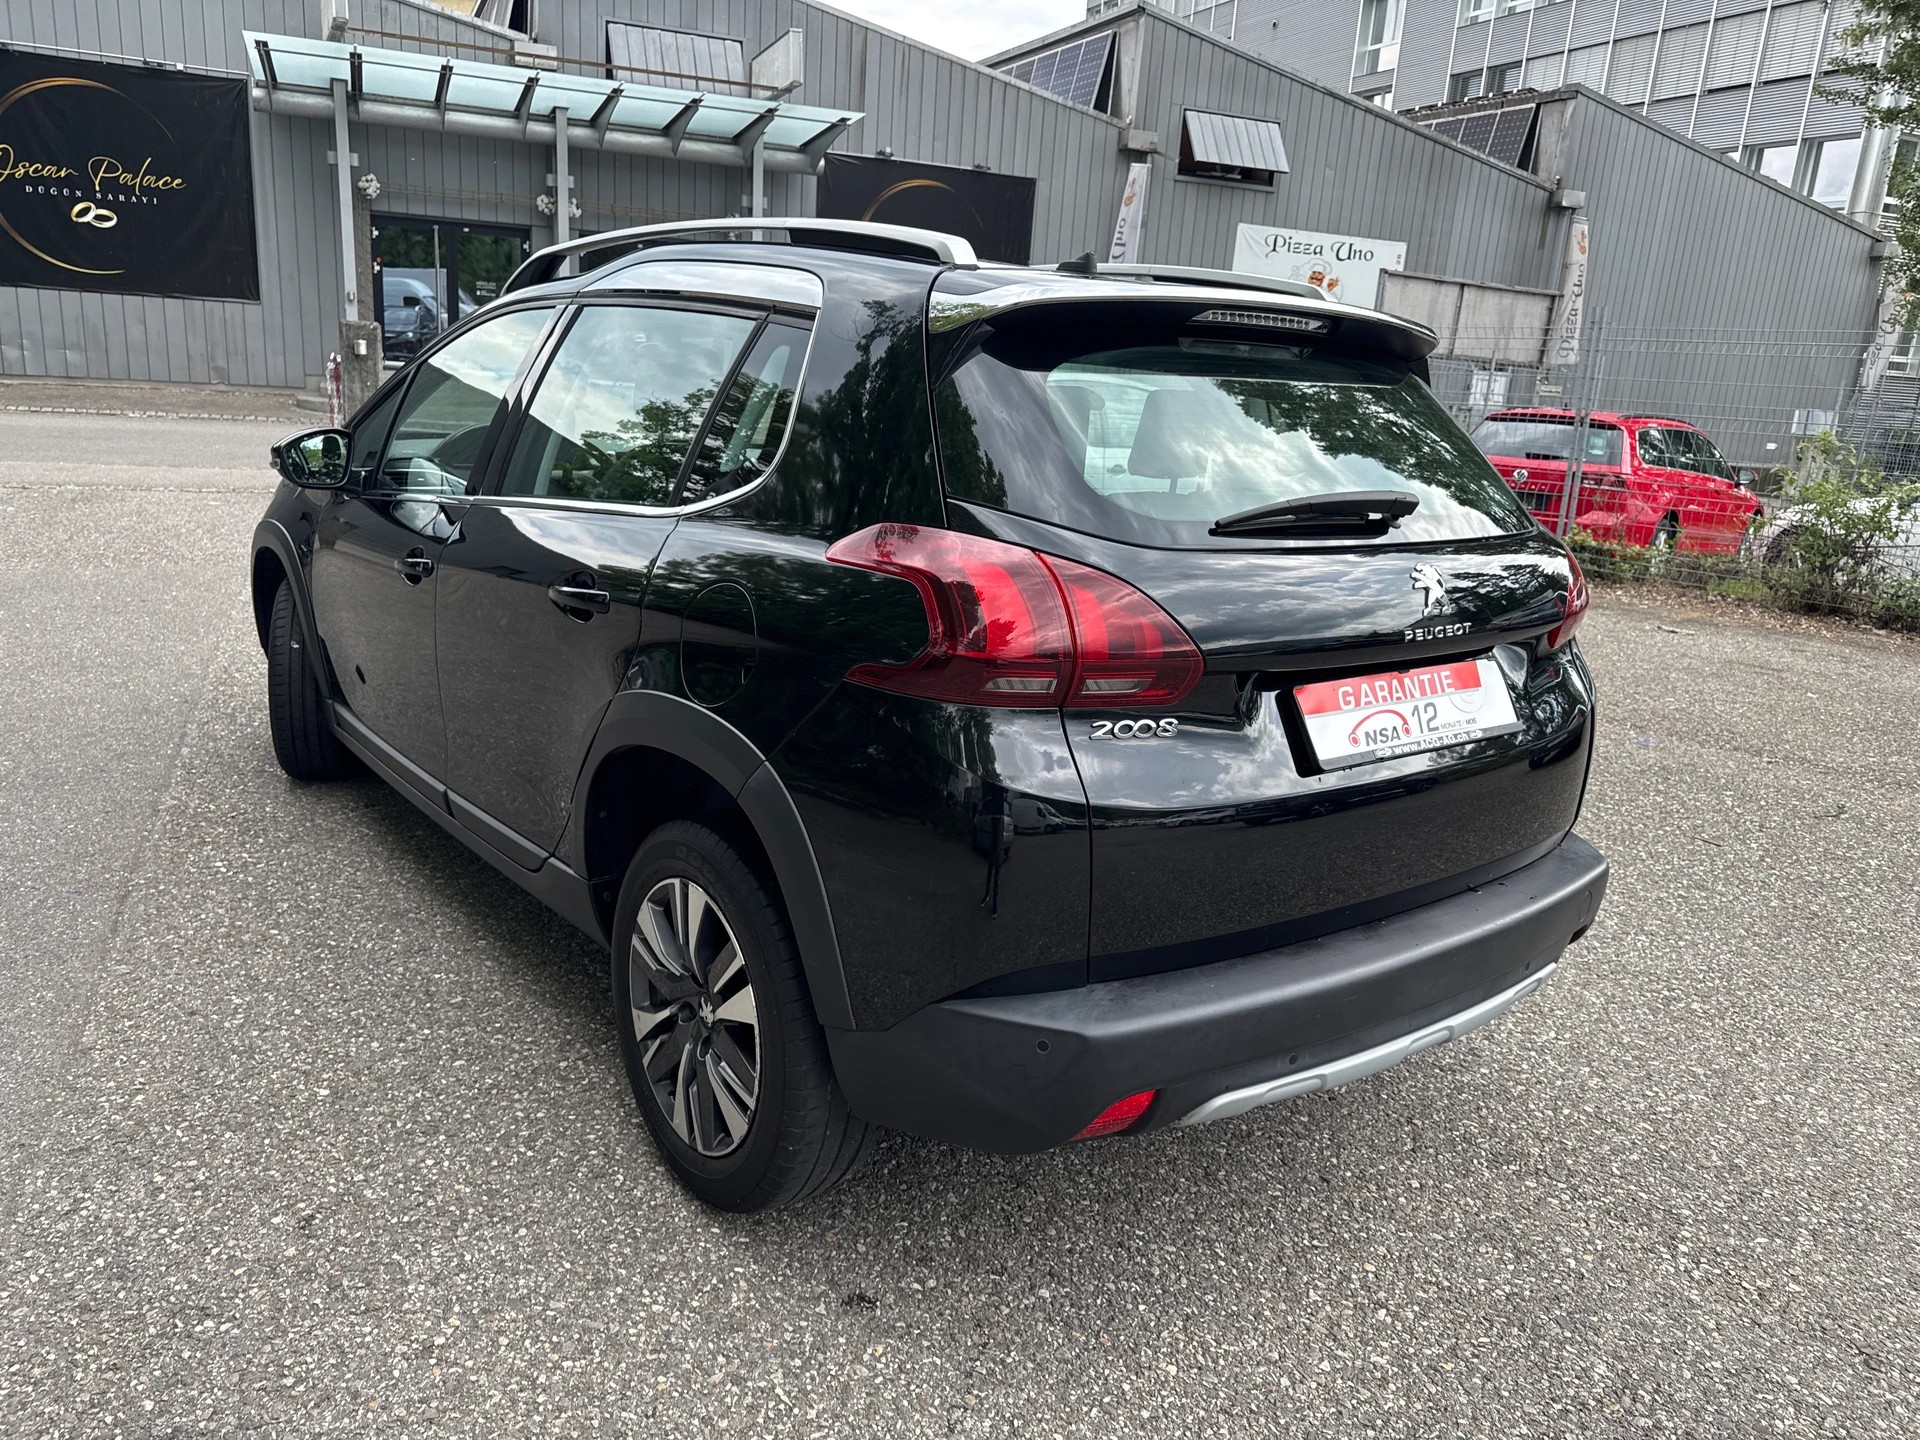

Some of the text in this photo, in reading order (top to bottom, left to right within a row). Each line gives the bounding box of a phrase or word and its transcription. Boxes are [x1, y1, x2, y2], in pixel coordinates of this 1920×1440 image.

[88, 156, 187, 195] Palace
[1264, 233, 1324, 259] Pizza
[1330, 240, 1374, 262] Uno
[1557, 308, 1579, 359] Pizza
[1404, 622, 1472, 643] PEUGEOT
[1338, 670, 1455, 711] GARANTIE
[1089, 718, 1178, 740] 2008
[1411, 702, 1440, 734] 12
[1364, 726, 1400, 747] NSA
[1393, 732, 1469, 755] www.ACG-AG.ch
